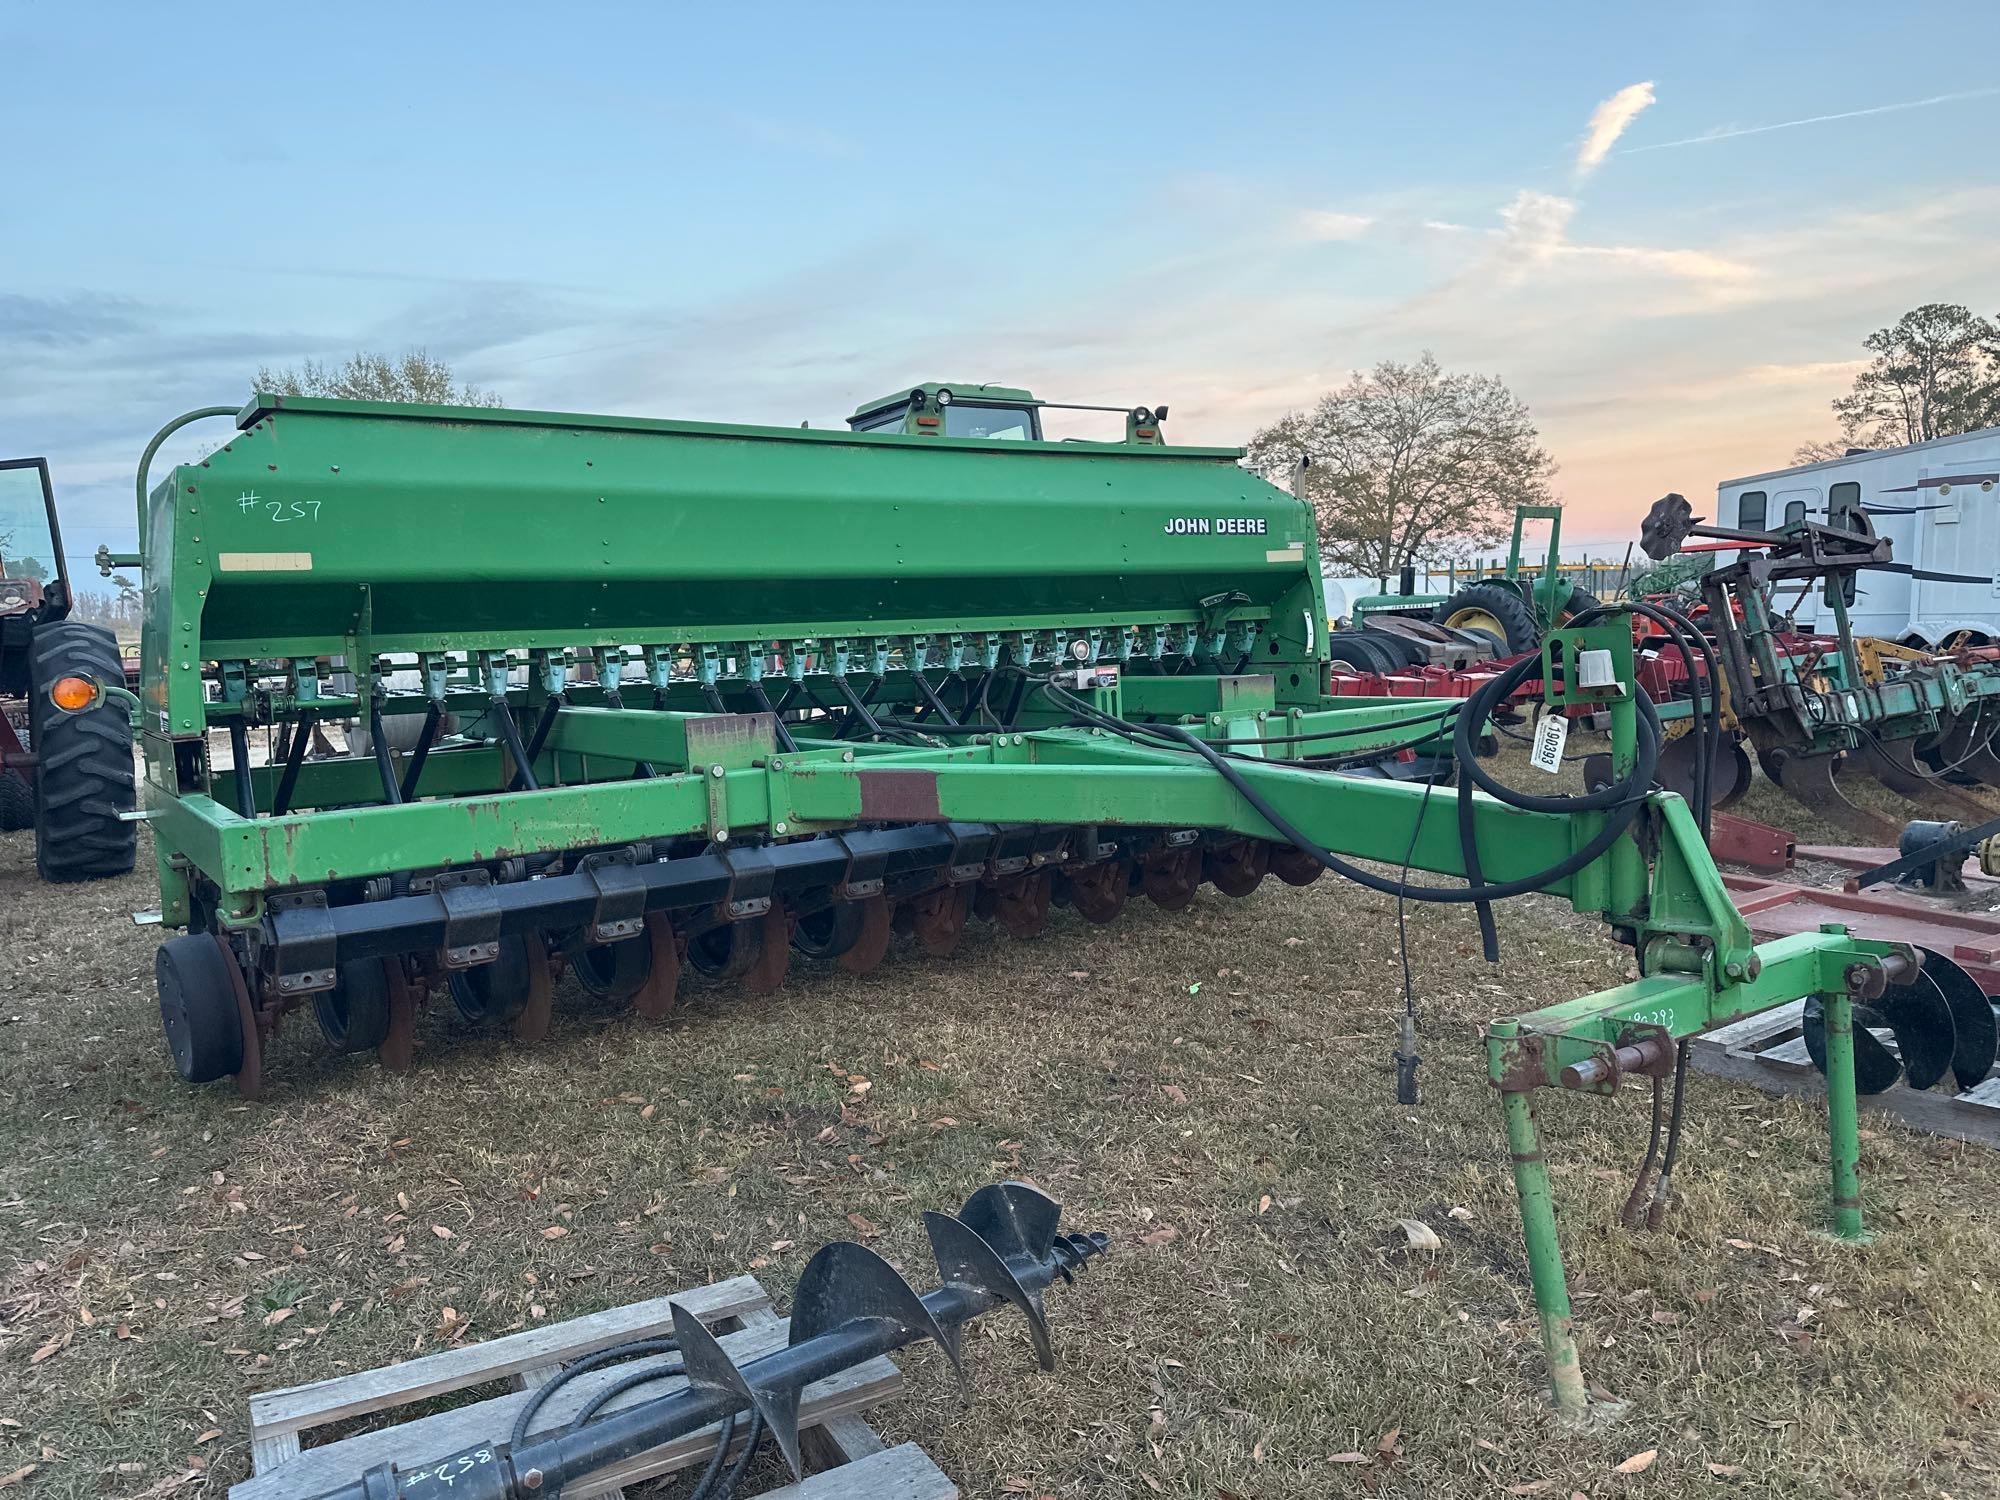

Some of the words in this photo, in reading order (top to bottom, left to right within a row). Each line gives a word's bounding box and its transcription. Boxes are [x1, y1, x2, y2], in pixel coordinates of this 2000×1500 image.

[1164, 518, 1211, 535] JOHN
[1216, 518, 1267, 534] DEERE
[1541, 727, 1562, 765] 190393
[406, 1449, 492, 1486] #258
